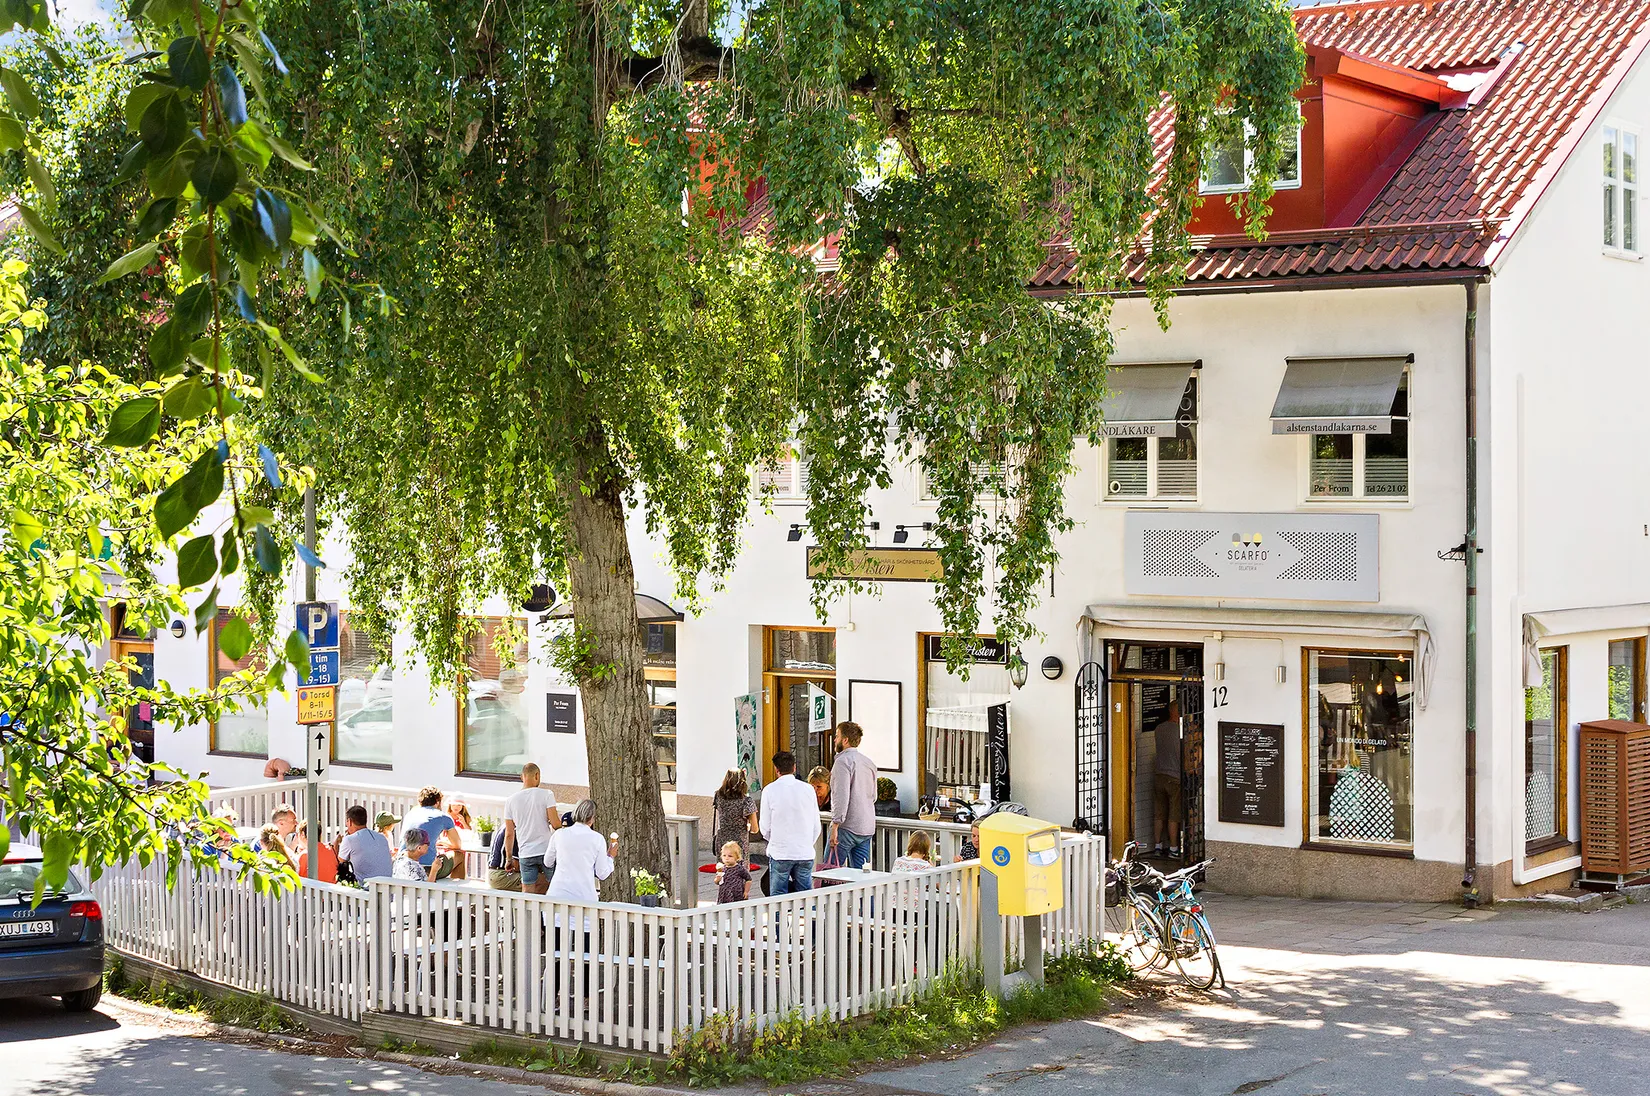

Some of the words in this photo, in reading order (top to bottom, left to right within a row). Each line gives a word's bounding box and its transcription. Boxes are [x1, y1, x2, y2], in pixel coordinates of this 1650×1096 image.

[1096, 425, 1156, 436] ANDLÄKARE
[1286, 422, 1378, 432] alstenstandlakarna.se
[1313, 484, 1326, 493] Per
[1328, 484, 1350, 493] From
[1365, 484, 1376, 493] Tel
[1376, 484, 1387, 493] 26
[1387, 484, 1396, 493] 21
[1397, 484, 1407, 493] 02
[308, 607, 328, 645] P
[315, 654, 328, 663] tim
[310, 690, 330, 699] Torsd
[1212, 686, 1228, 708] 12
[309, 701, 324, 709] 8-11
[300, 710, 333, 720] 1/11-15/5
[0, 923, 21, 936] XUJ
[29, 921, 52, 934] 493
